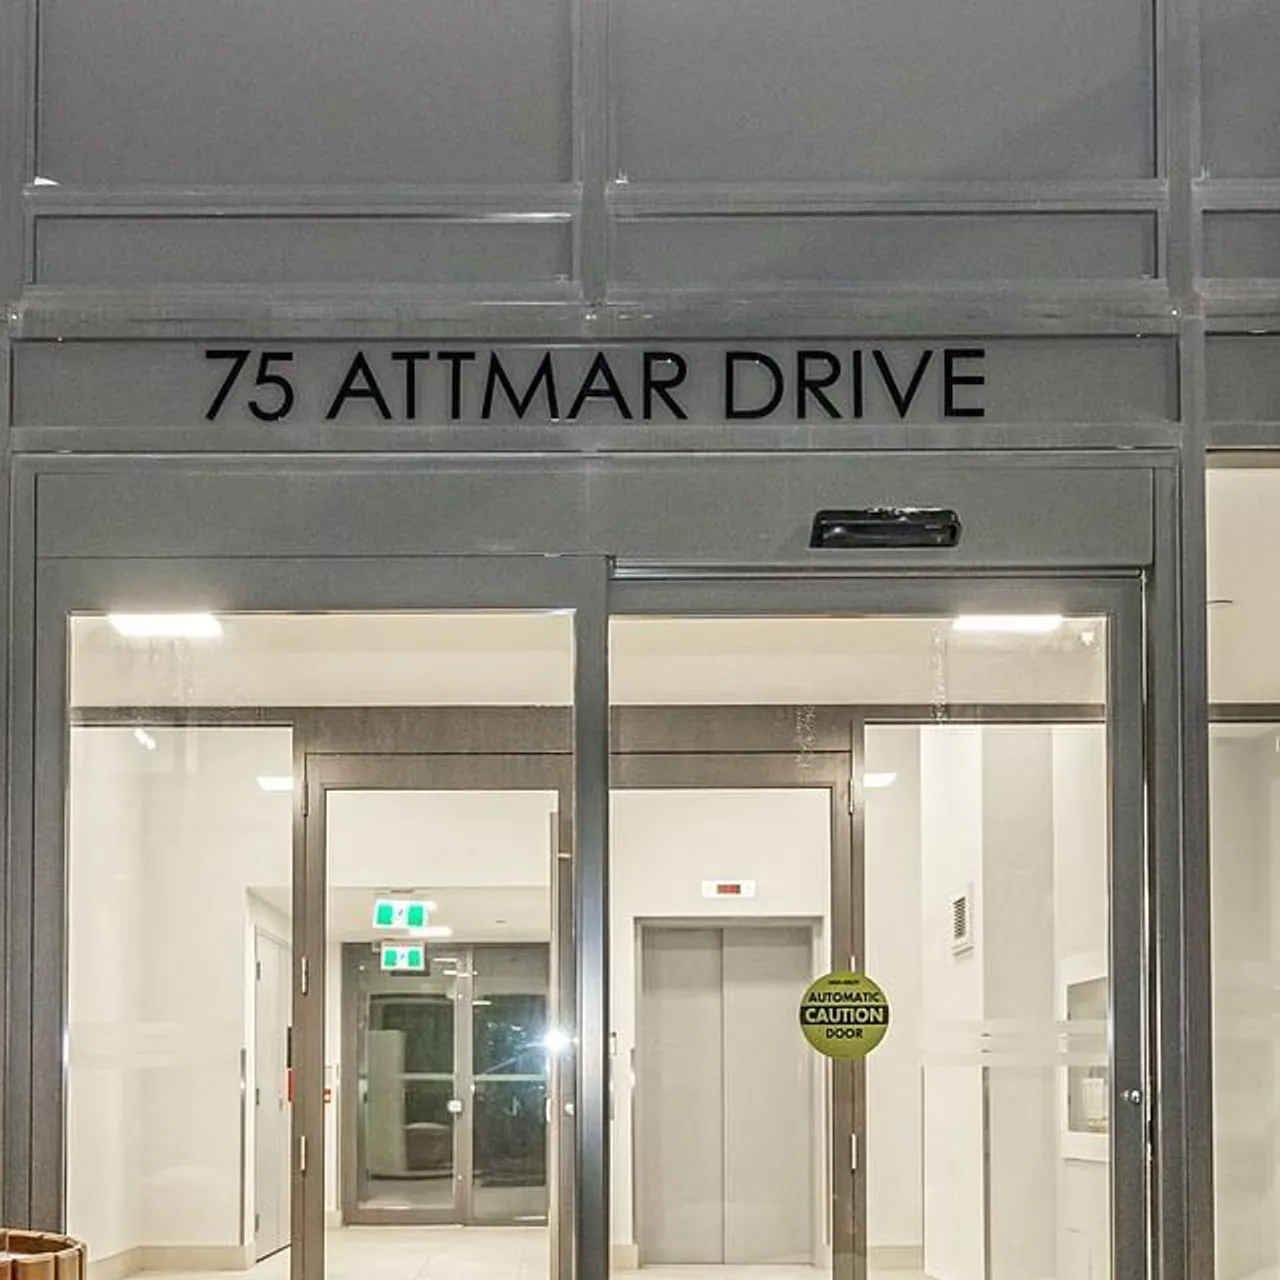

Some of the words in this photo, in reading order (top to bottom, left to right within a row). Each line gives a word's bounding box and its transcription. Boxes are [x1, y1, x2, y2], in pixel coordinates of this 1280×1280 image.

[205, 349, 294, 422] 75
[324, 350, 689, 420] ATTMAR
[724, 348, 986, 420] DRIVE
[808, 991, 880, 1003] AUTOMATIC
[805, 1007, 884, 1023] CAUTION
[826, 1028, 863, 1039] DOOR
